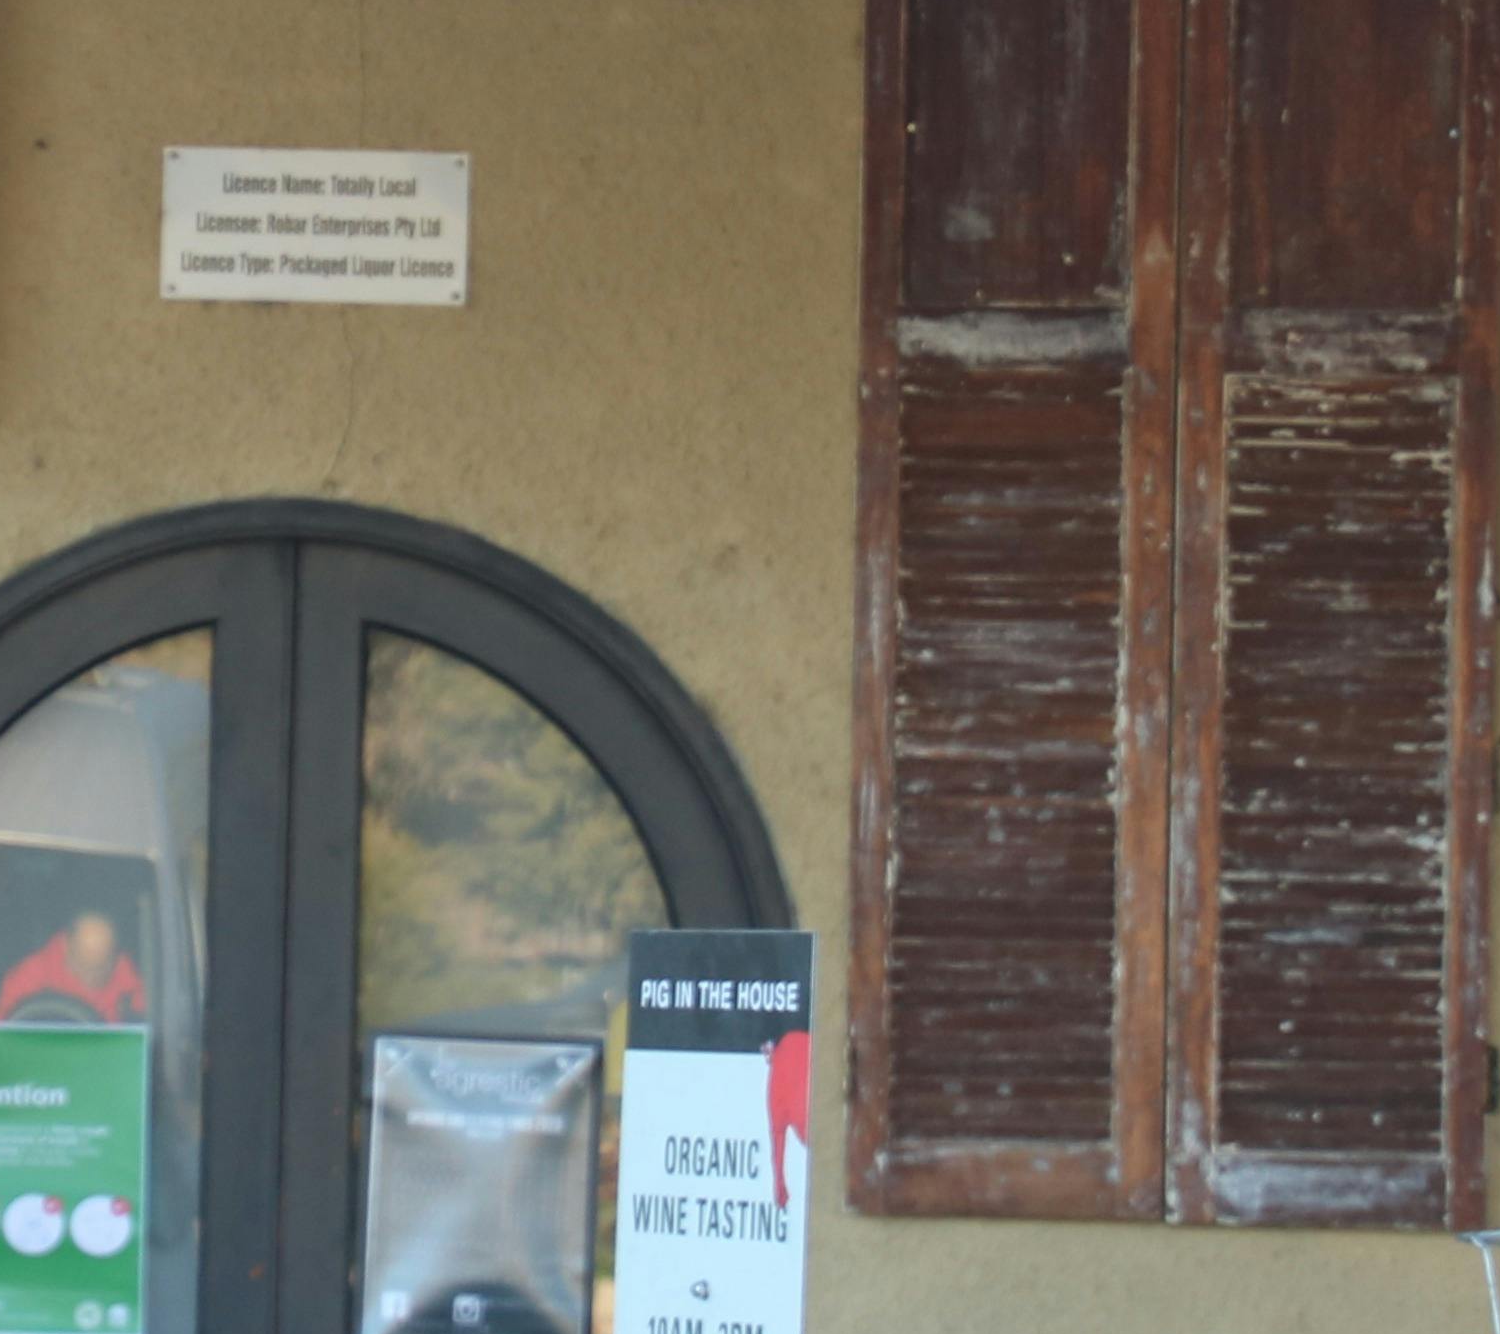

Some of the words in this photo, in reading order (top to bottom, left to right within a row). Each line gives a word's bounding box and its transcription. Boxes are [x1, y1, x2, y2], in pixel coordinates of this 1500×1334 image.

[222, 172, 277, 195] Licence
[281, 174, 325, 196] Name:
[331, 175, 375, 198] Totally
[379, 176, 416, 197] Local
[196, 212, 262, 234] Licensee:
[312, 215, 390, 238] Enterprises
[395, 217, 416, 238] Pty
[421, 217, 442, 238] Ltd
[180, 251, 235, 274] Licence
[240, 252, 274, 276] Type:
[279, 254, 348, 277] Packaged
[352, 255, 396, 278] Liquor
[400, 257, 454, 278] Licence
[640, 979, 670, 1009] PIG
[674, 980, 693, 1009] IN
[697, 980, 733, 1010] THE
[737, 981, 800, 1012] HOUSE
[663, 1135, 760, 1180] ORGANIC
[632, 1194, 688, 1237] WINE
[696, 1197, 788, 1244] TASTING
